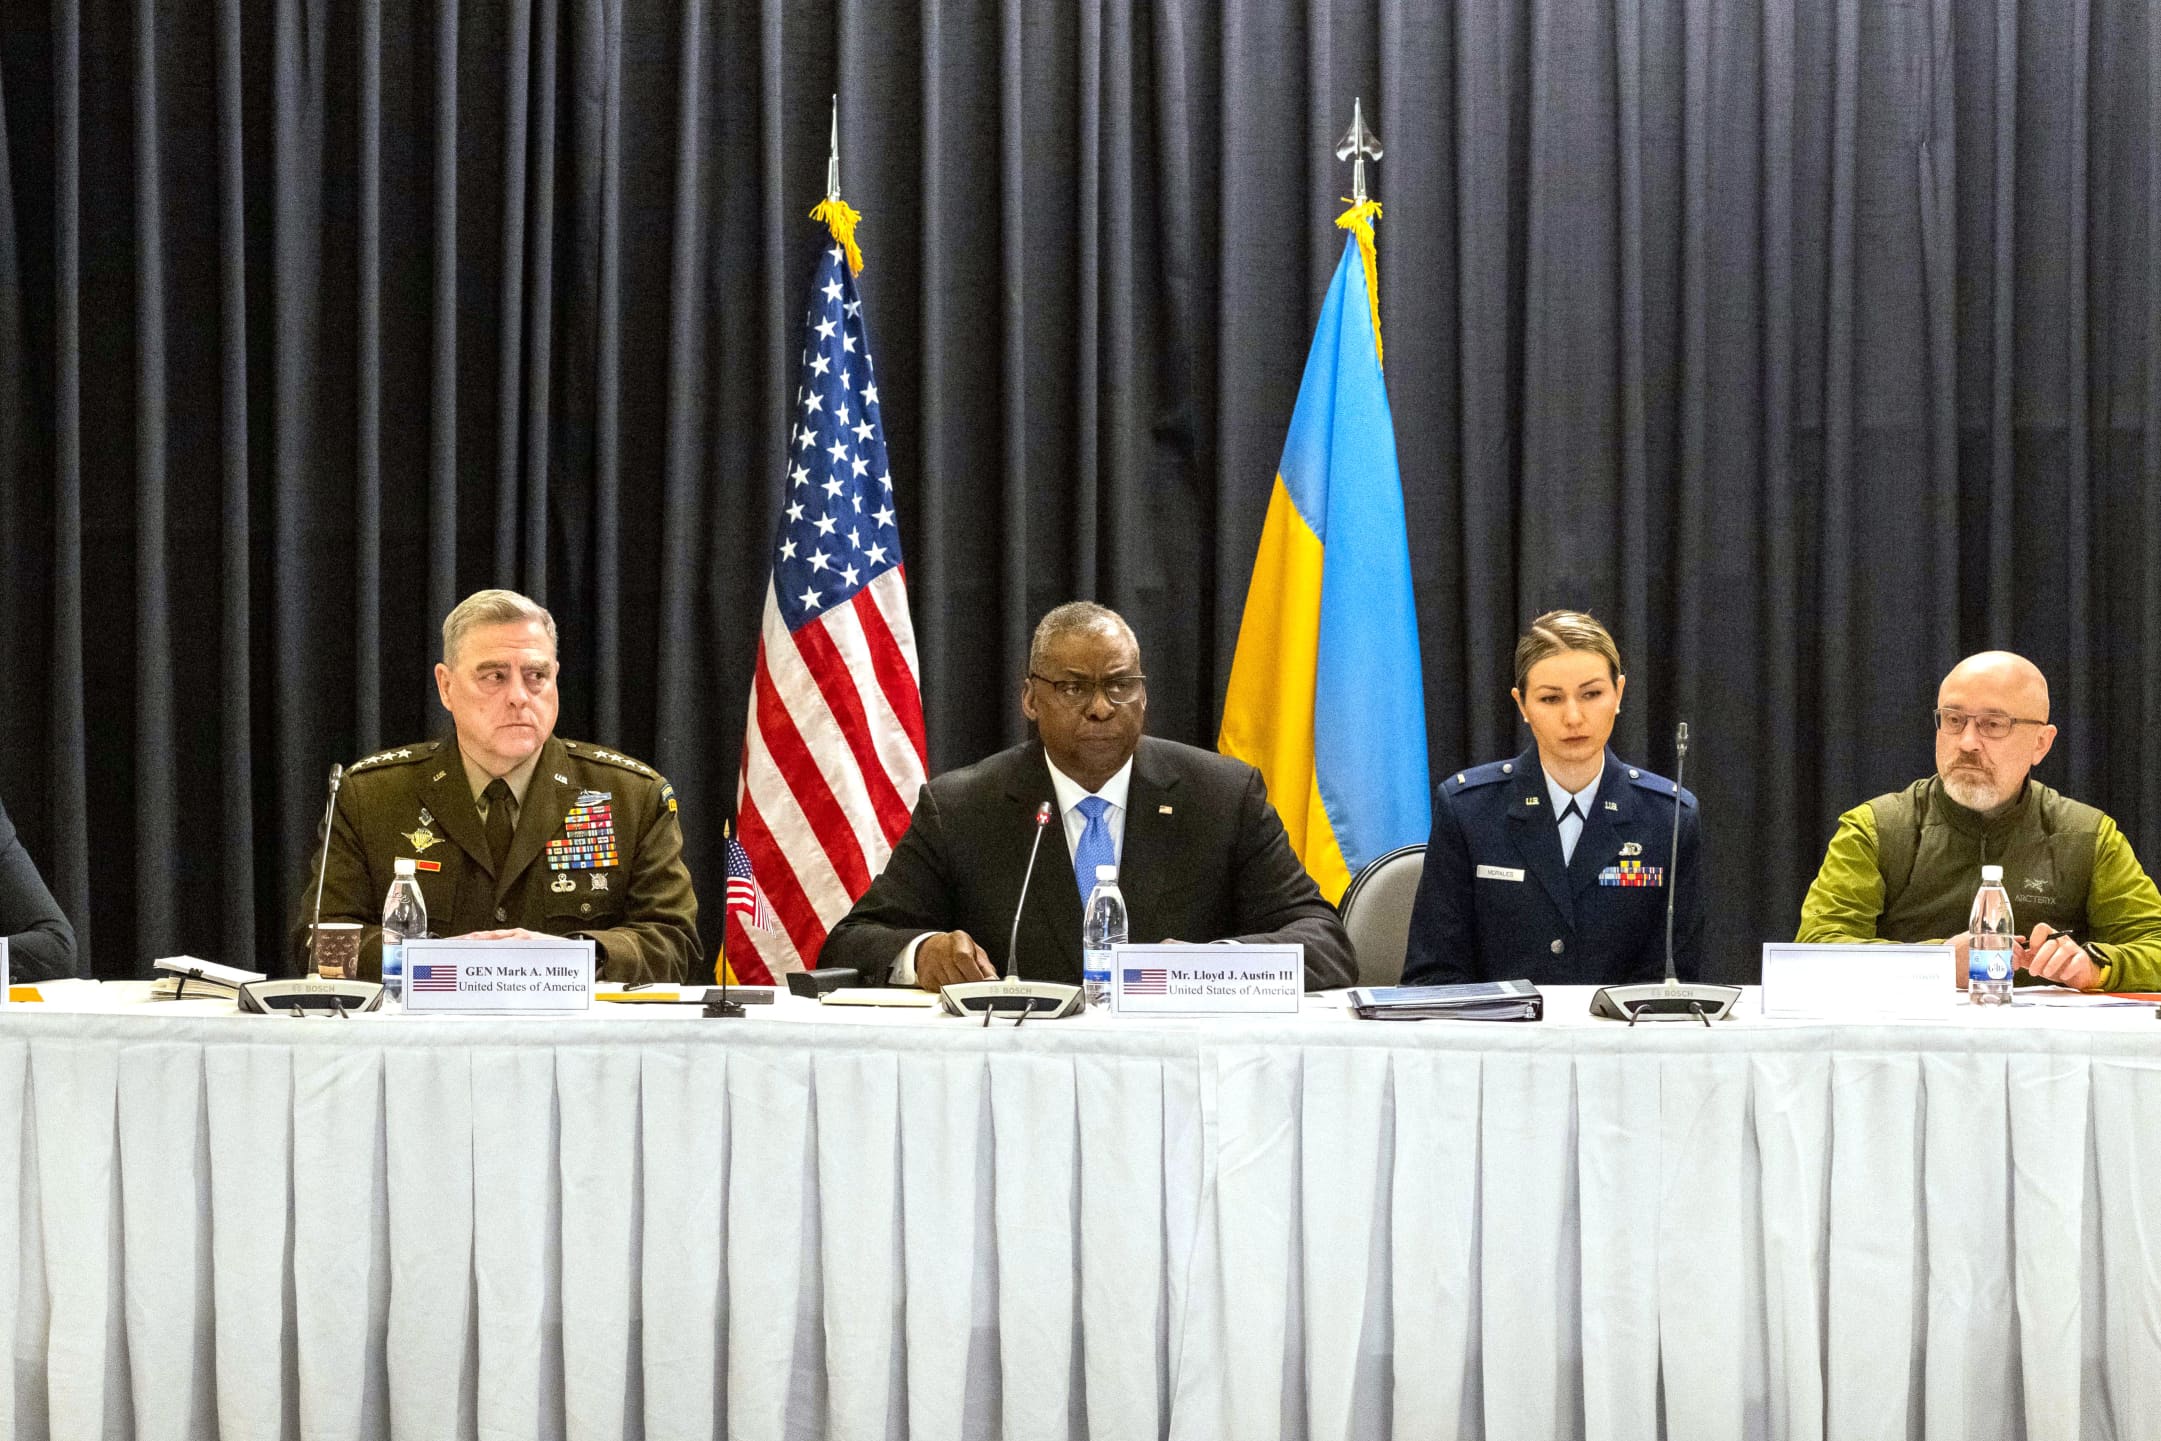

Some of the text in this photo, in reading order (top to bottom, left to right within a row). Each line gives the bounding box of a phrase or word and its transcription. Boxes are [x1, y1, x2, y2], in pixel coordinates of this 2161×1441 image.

[465, 966, 580, 979] GEN Mark A. Milley
[1171, 970, 1293, 983] Mr. Lloyd J. Austin III
[305, 984, 335, 993] BOSCH
[458, 981, 587, 992] United States of America
[1003, 986, 1032, 995] BOSCH
[1169, 985, 1297, 996] United States of America
[1664, 989, 1694, 998] BOSCH
